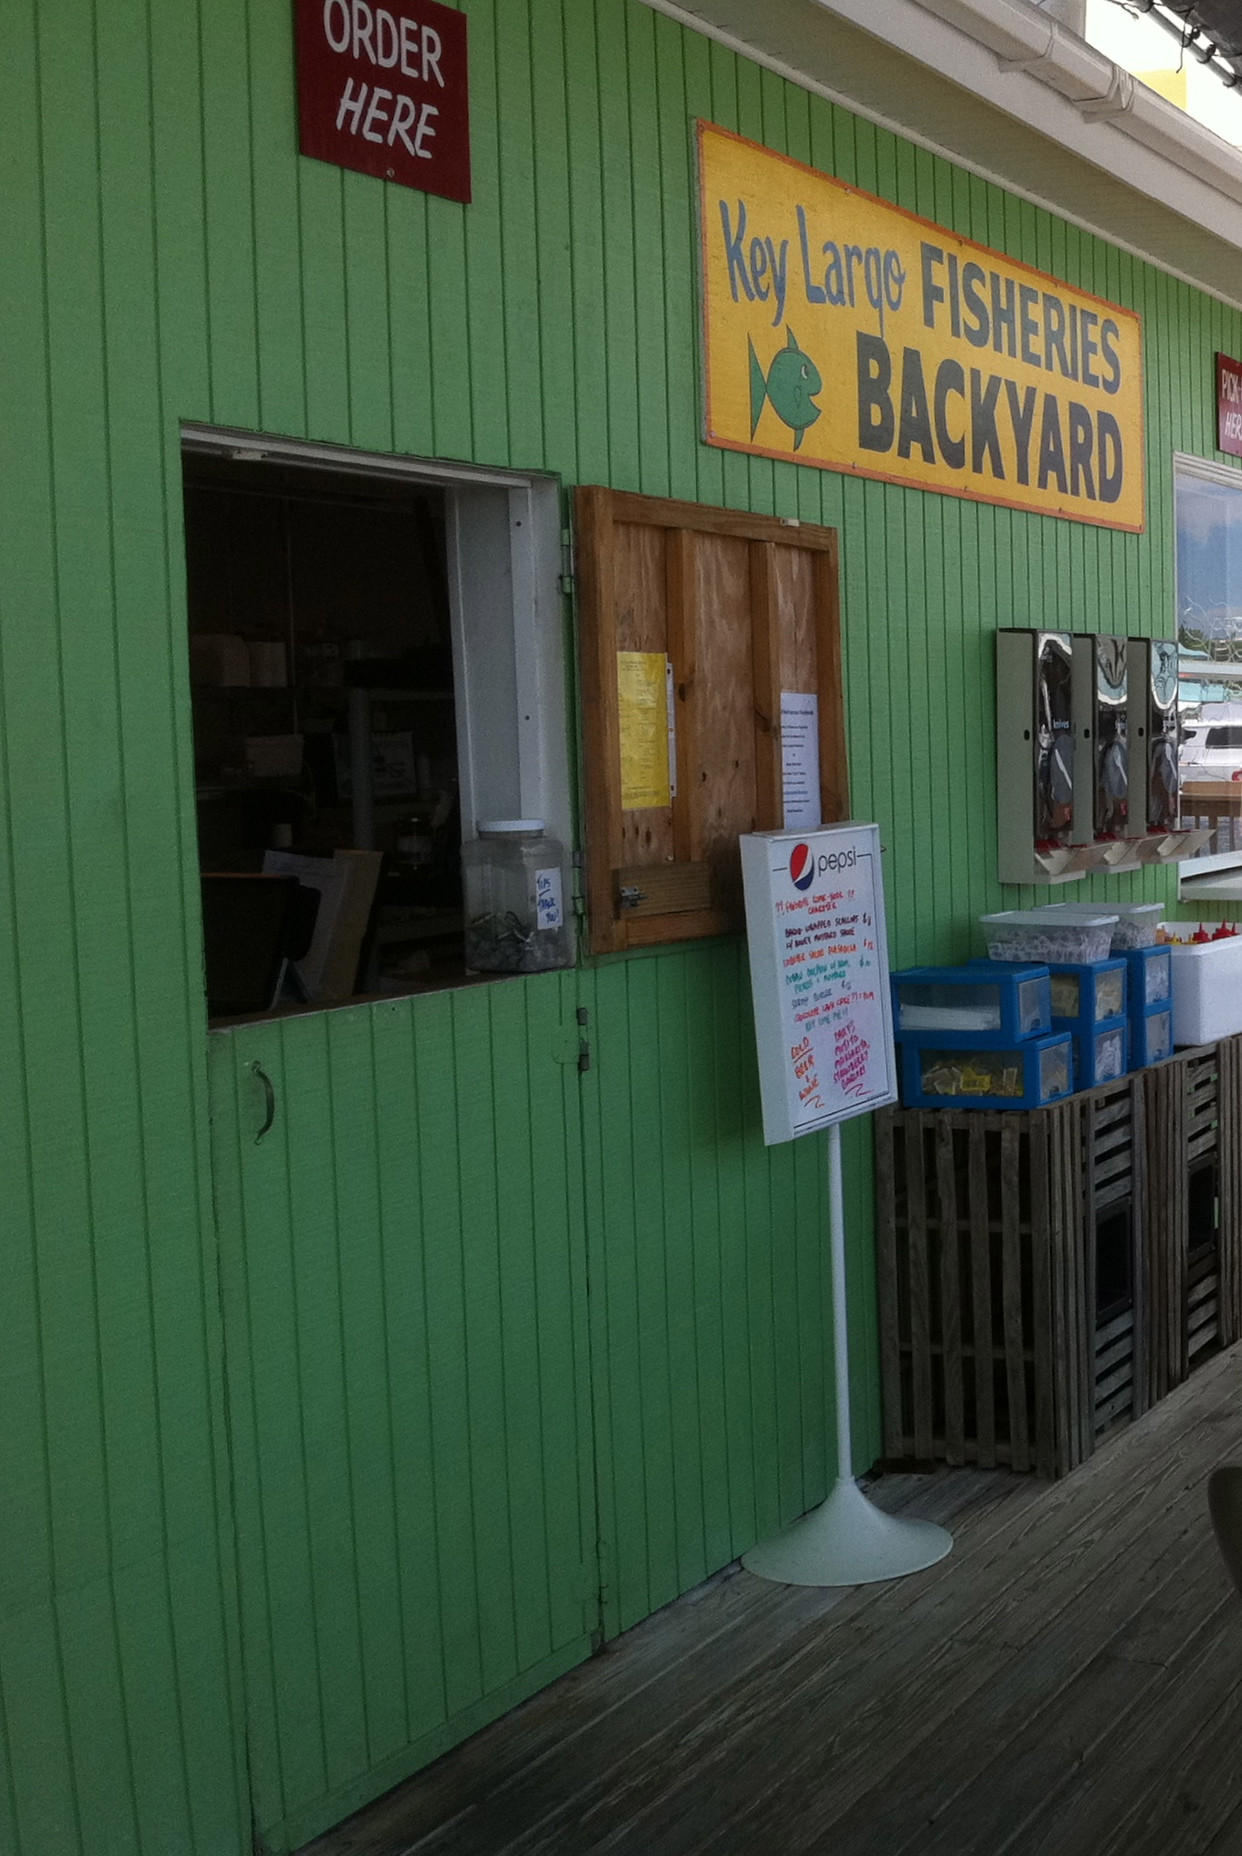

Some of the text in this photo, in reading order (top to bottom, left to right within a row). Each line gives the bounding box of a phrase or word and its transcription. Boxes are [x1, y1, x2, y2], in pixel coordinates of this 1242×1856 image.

[324, 0, 445, 88] ORDER
[336, 77, 439, 159] HERE
[719, 199, 1120, 395] Key Largo FISHERIES
[856, 330, 1123, 504] BACKYARD
[818, 845, 856, 877] pepsi
[791, 1036, 810, 1060] COLD
[794, 1054, 814, 1079] BEER
